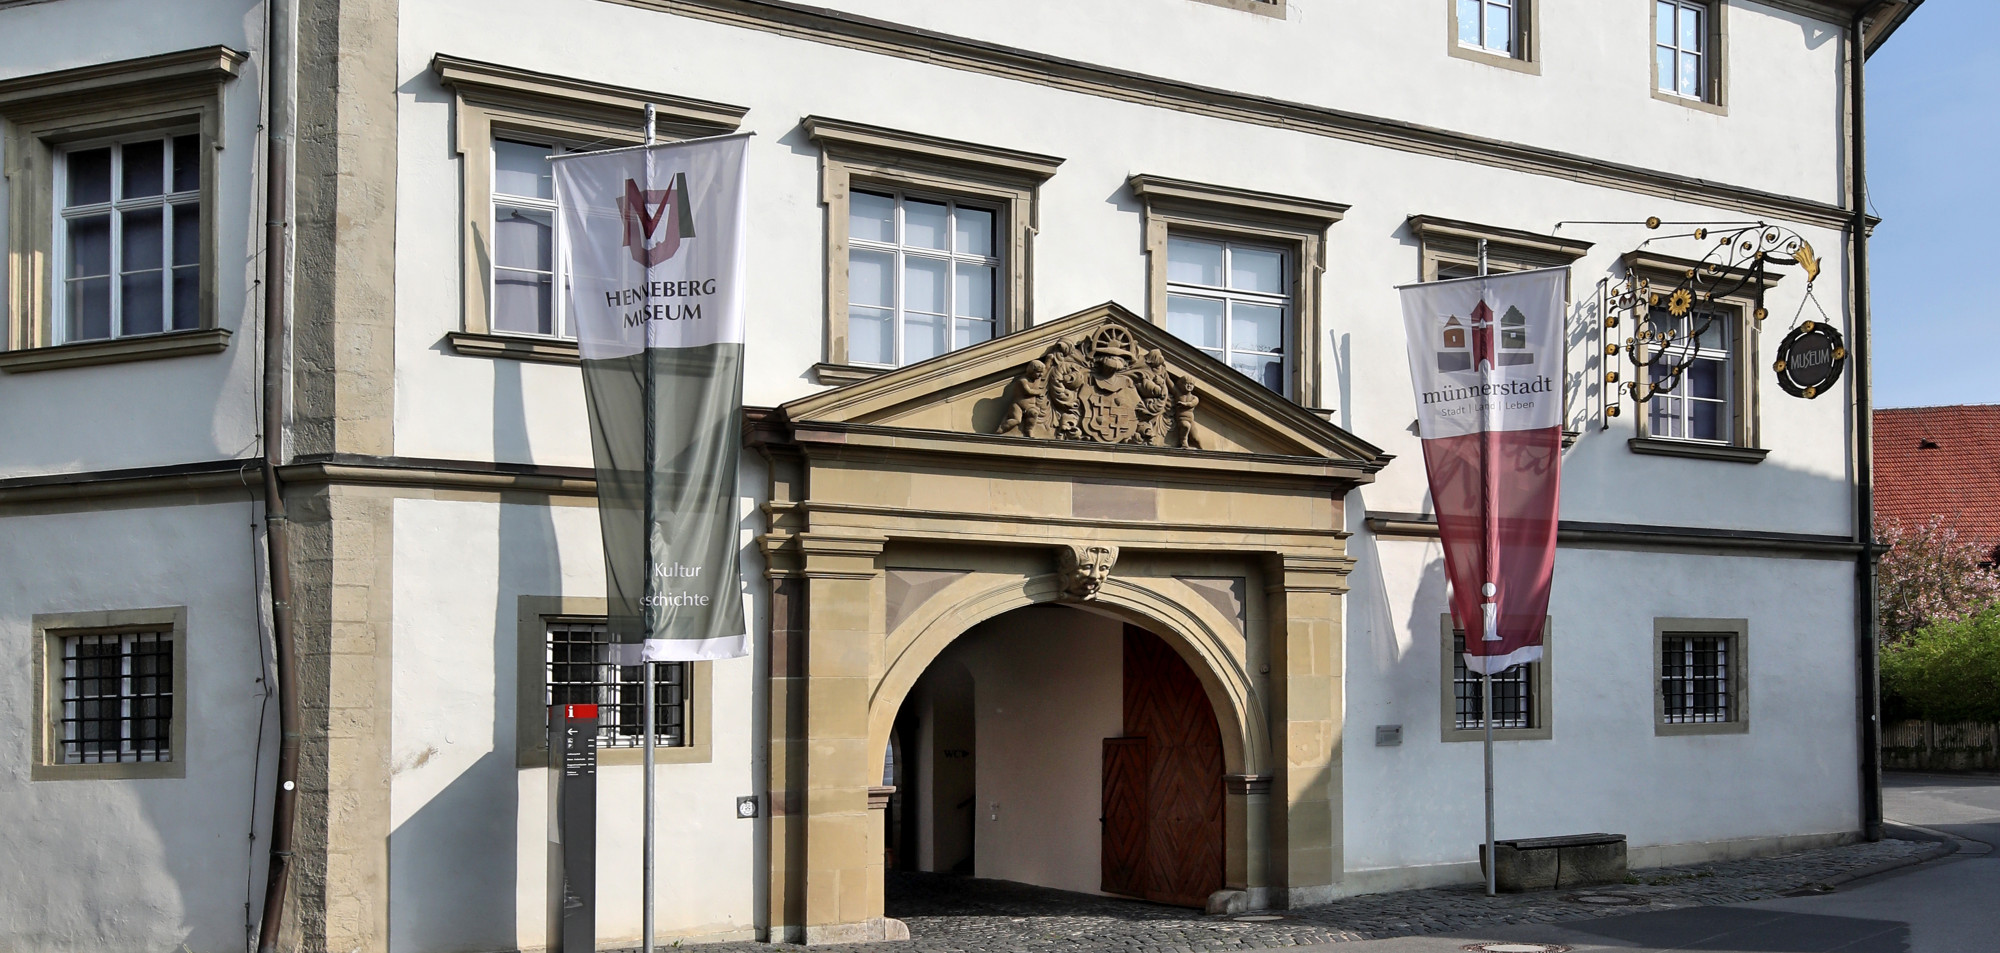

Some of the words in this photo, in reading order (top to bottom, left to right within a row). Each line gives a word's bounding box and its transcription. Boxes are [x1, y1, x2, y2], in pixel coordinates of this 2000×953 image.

[605, 278, 716, 307] HENNEBERG
[623, 304, 702, 329] MUSEUM
[1790, 348, 1830, 370] MUSEUM
[1422, 375, 1553, 405] münnerstadt
[1441, 406, 1466, 417] Stadt
[1474, 402, 1496, 412] Land
[1505, 401, 1535, 410] Leben
[654, 562, 702, 577] Kultur
[1480, 582, 1503, 641] i
[567, 705, 575, 718] i
[943, 749, 961, 759] WC
